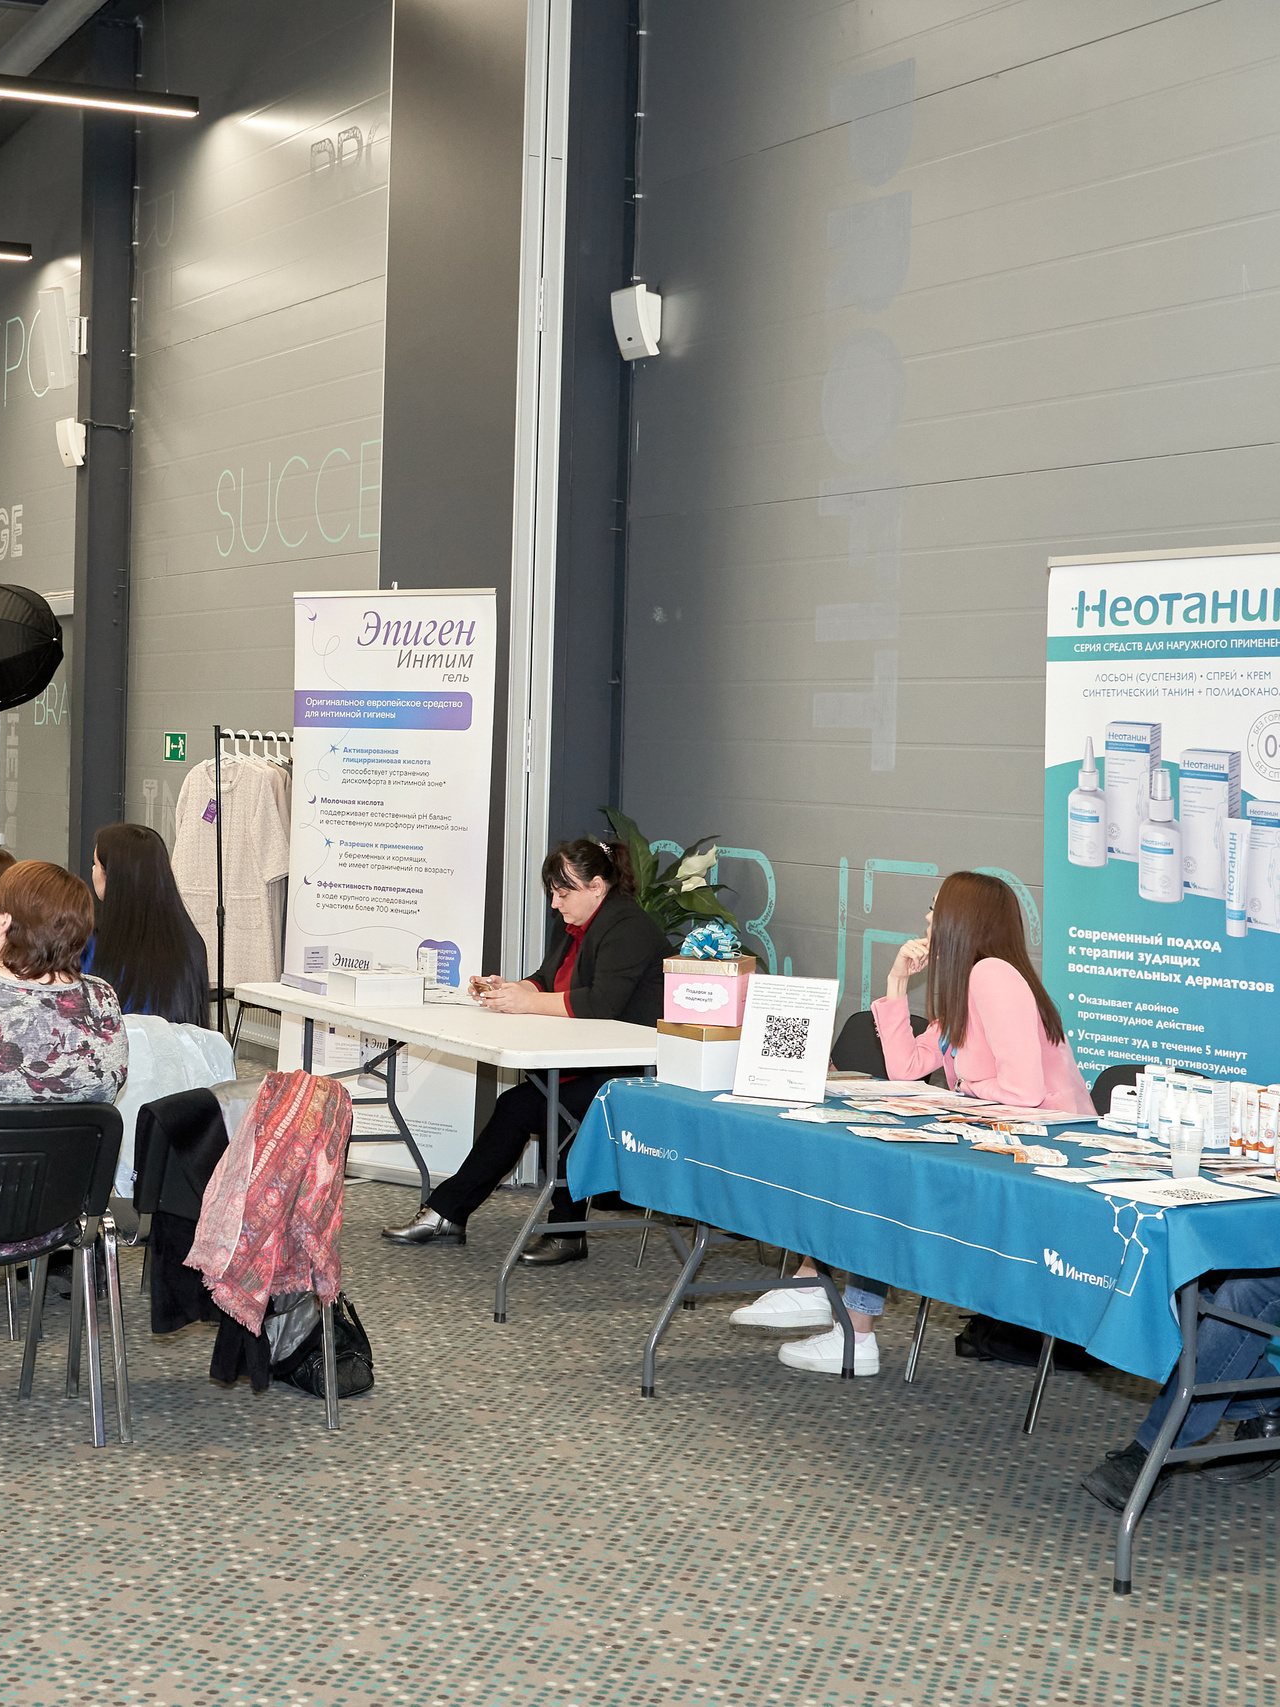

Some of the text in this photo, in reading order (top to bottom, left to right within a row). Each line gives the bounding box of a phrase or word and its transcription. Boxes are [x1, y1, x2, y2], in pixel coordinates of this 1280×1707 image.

[357, 610, 476, 646] Эпиген
[1073, 643, 1102, 653] СЕРИЯ
[1103, 642, 1143, 653] СРЕДСТВ
[1144, 642, 1164, 652] ДЛЯ
[1166, 639, 1228, 651] НАРУЖНОГО
[396, 649, 474, 669] Интим
[441, 672, 470, 683] гель
[1095, 669, 1272, 684] ЛОСЬОН (СУСПЕНЗИЯ) СПРЕЙ КРЕМ
[1082, 686, 1280, 698] СИНТЕТИЧЕСКИЙ ТАНИН ПОЛИДОКАНО
[305, 697, 463, 710] Оригинальное европейское средство
[304, 709, 396, 719] для интимной гигиены
[1108, 731, 1147, 742] Неотанин
[343, 746, 399, 755] Активированная
[1183, 760, 1225, 771] Неотанин
[1254, 760, 1268, 774] БЕЗ
[341, 767, 430, 778] способствует устранению
[341, 778, 387, 786] дискомфорта
[320, 797, 356, 805] Молочная
[320, 809, 369, 817] поддерживает
[370, 811, 416, 820] естественный
[428, 813, 452, 821] баланс
[1250, 808, 1279, 817] Неотанин
[325, 820, 372, 828] естественную
[374, 821, 415, 830] микрофлору
[416, 823, 449, 831] интимной
[339, 840, 374, 849] Разрешен
[380, 843, 424, 851] применению
[344, 851, 385, 861] беременных
[370, 863, 413, 872] ограничений
[424, 866, 455, 875] возрасту
[1227, 832, 1237, 903] Неотанин
[317, 880, 424, 894] Эффективность подтверждена
[339, 895, 370, 903] крупного
[370, 897, 418, 905] исследования
[321, 902, 354, 910] участием
[355, 903, 375, 912] более
[376, 905, 389, 913] 700
[1068, 926, 1222, 953] Современный подход
[332, 952, 370, 969] Эпиген
[1068, 945, 1201, 968] к терапии зудящих
[1068, 962, 1275, 994] воспалительных дерматозов
[1078, 993, 1179, 1015] Оказывает двойное
[1077, 1009, 1205, 1033] противозудное действие
[1077, 1028, 1248, 1061] Устраняет зуд в течение 5 минут
[1077, 1045, 1247, 1076] после нанесения, противозудное
